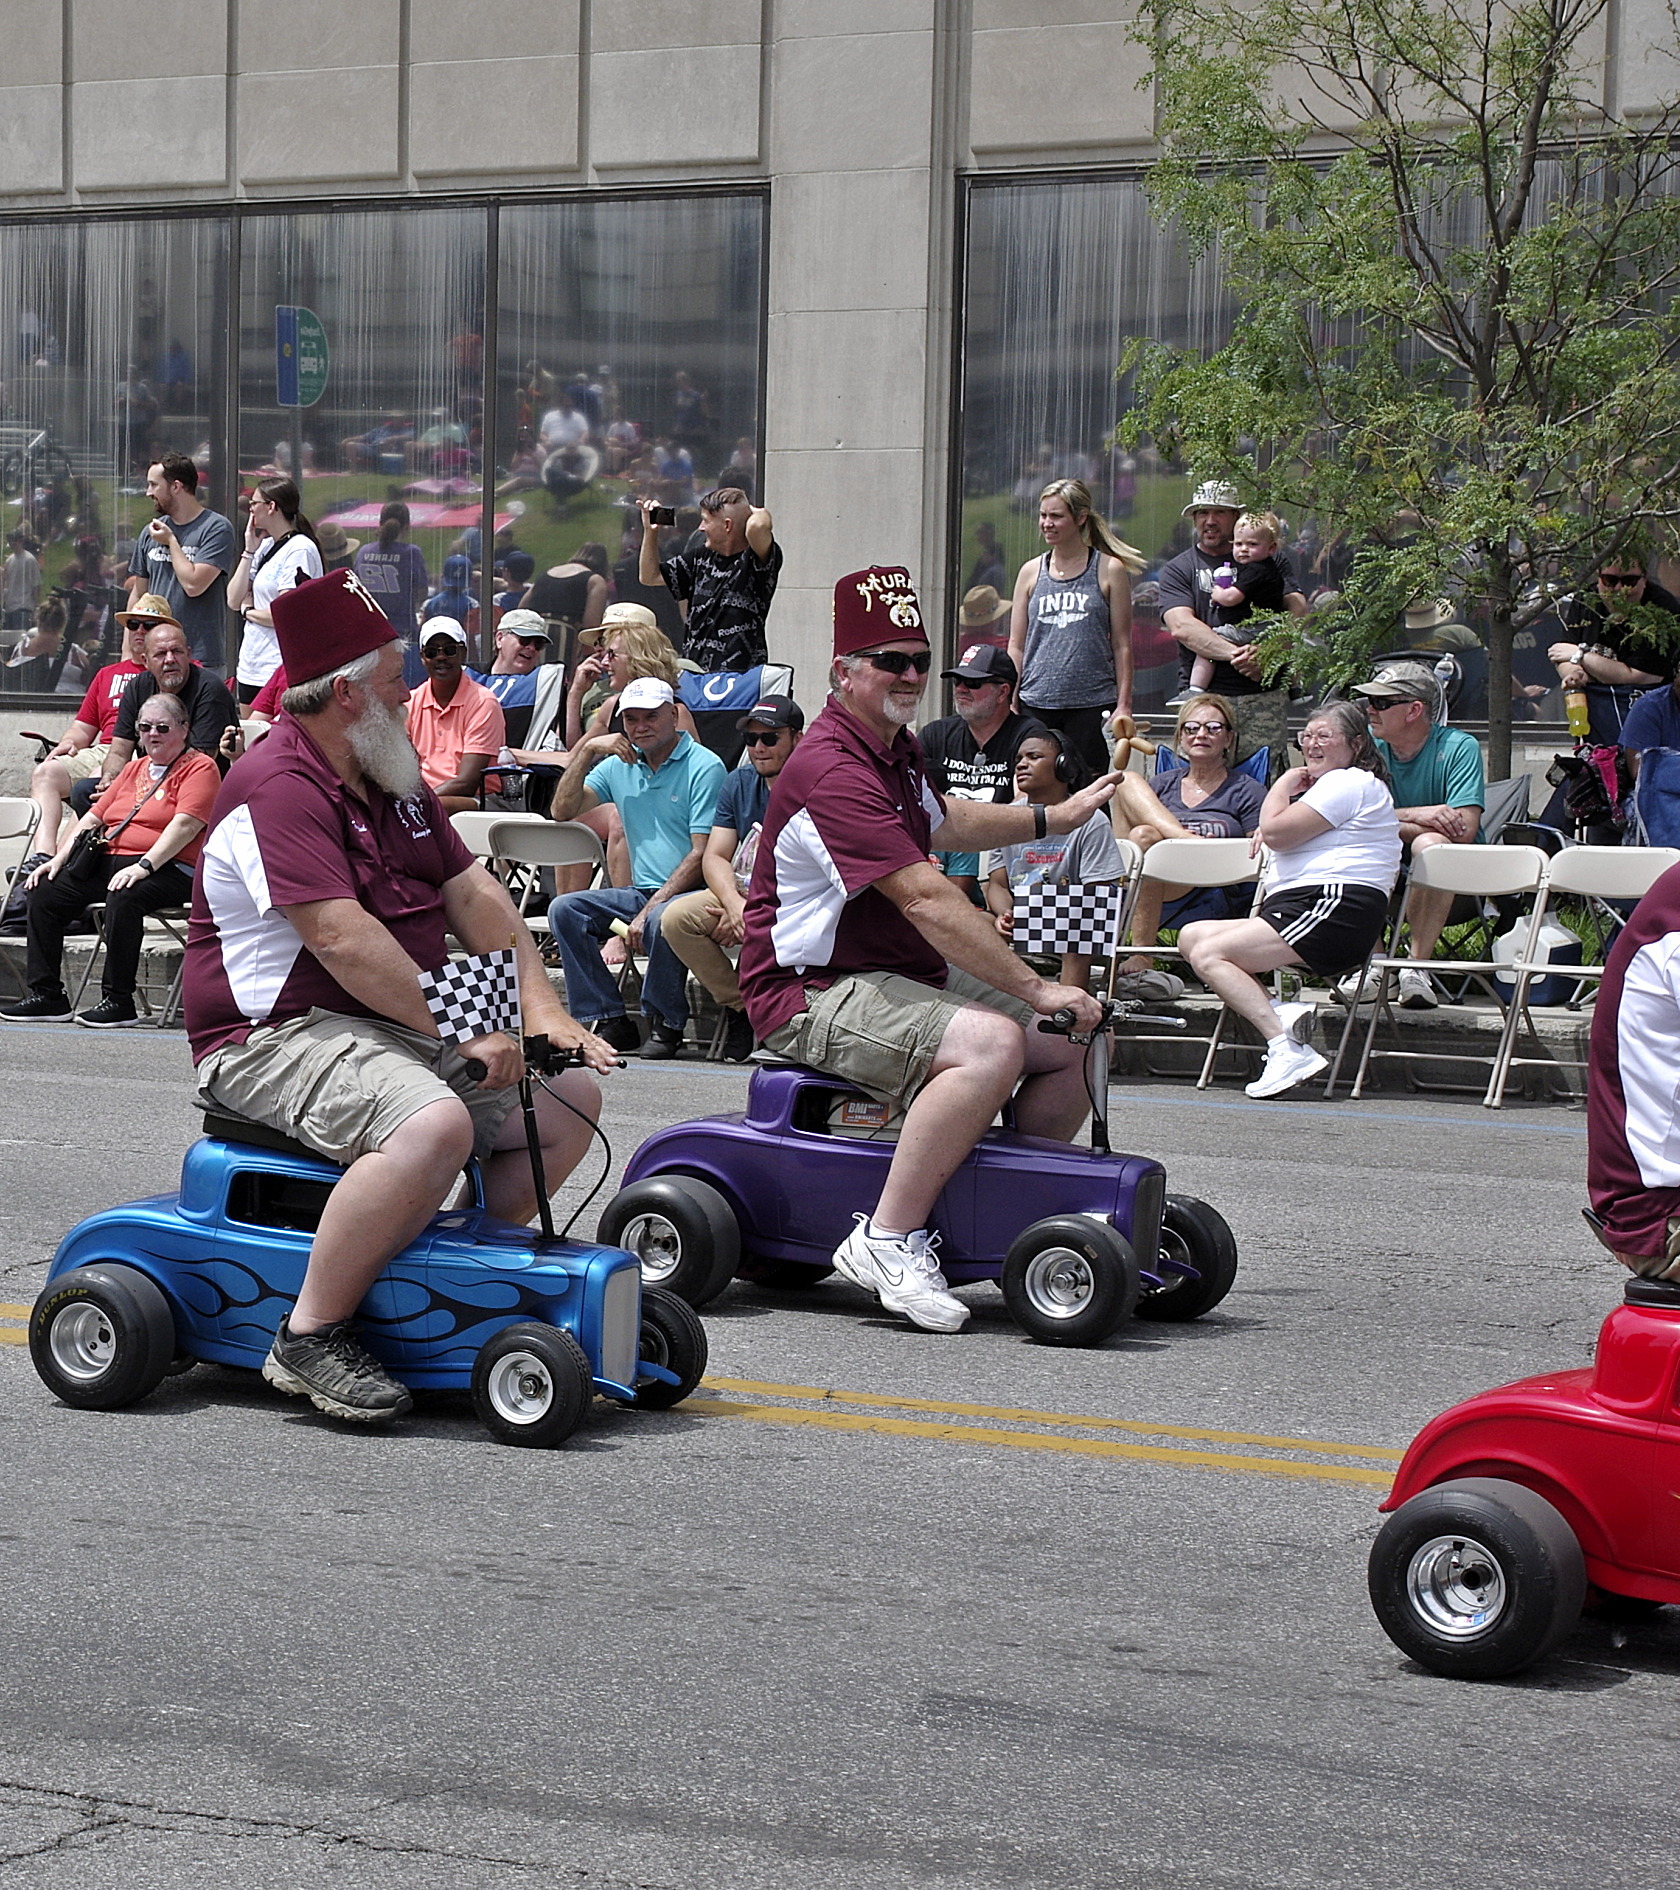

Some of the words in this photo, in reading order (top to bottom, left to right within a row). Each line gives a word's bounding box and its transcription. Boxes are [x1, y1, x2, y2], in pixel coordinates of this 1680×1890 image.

[1038, 591, 1089, 615] INDY
[718, 622, 751, 638] Reebok
[995, 776, 1011, 787] AN
[848, 1102, 868, 1114] BMI
